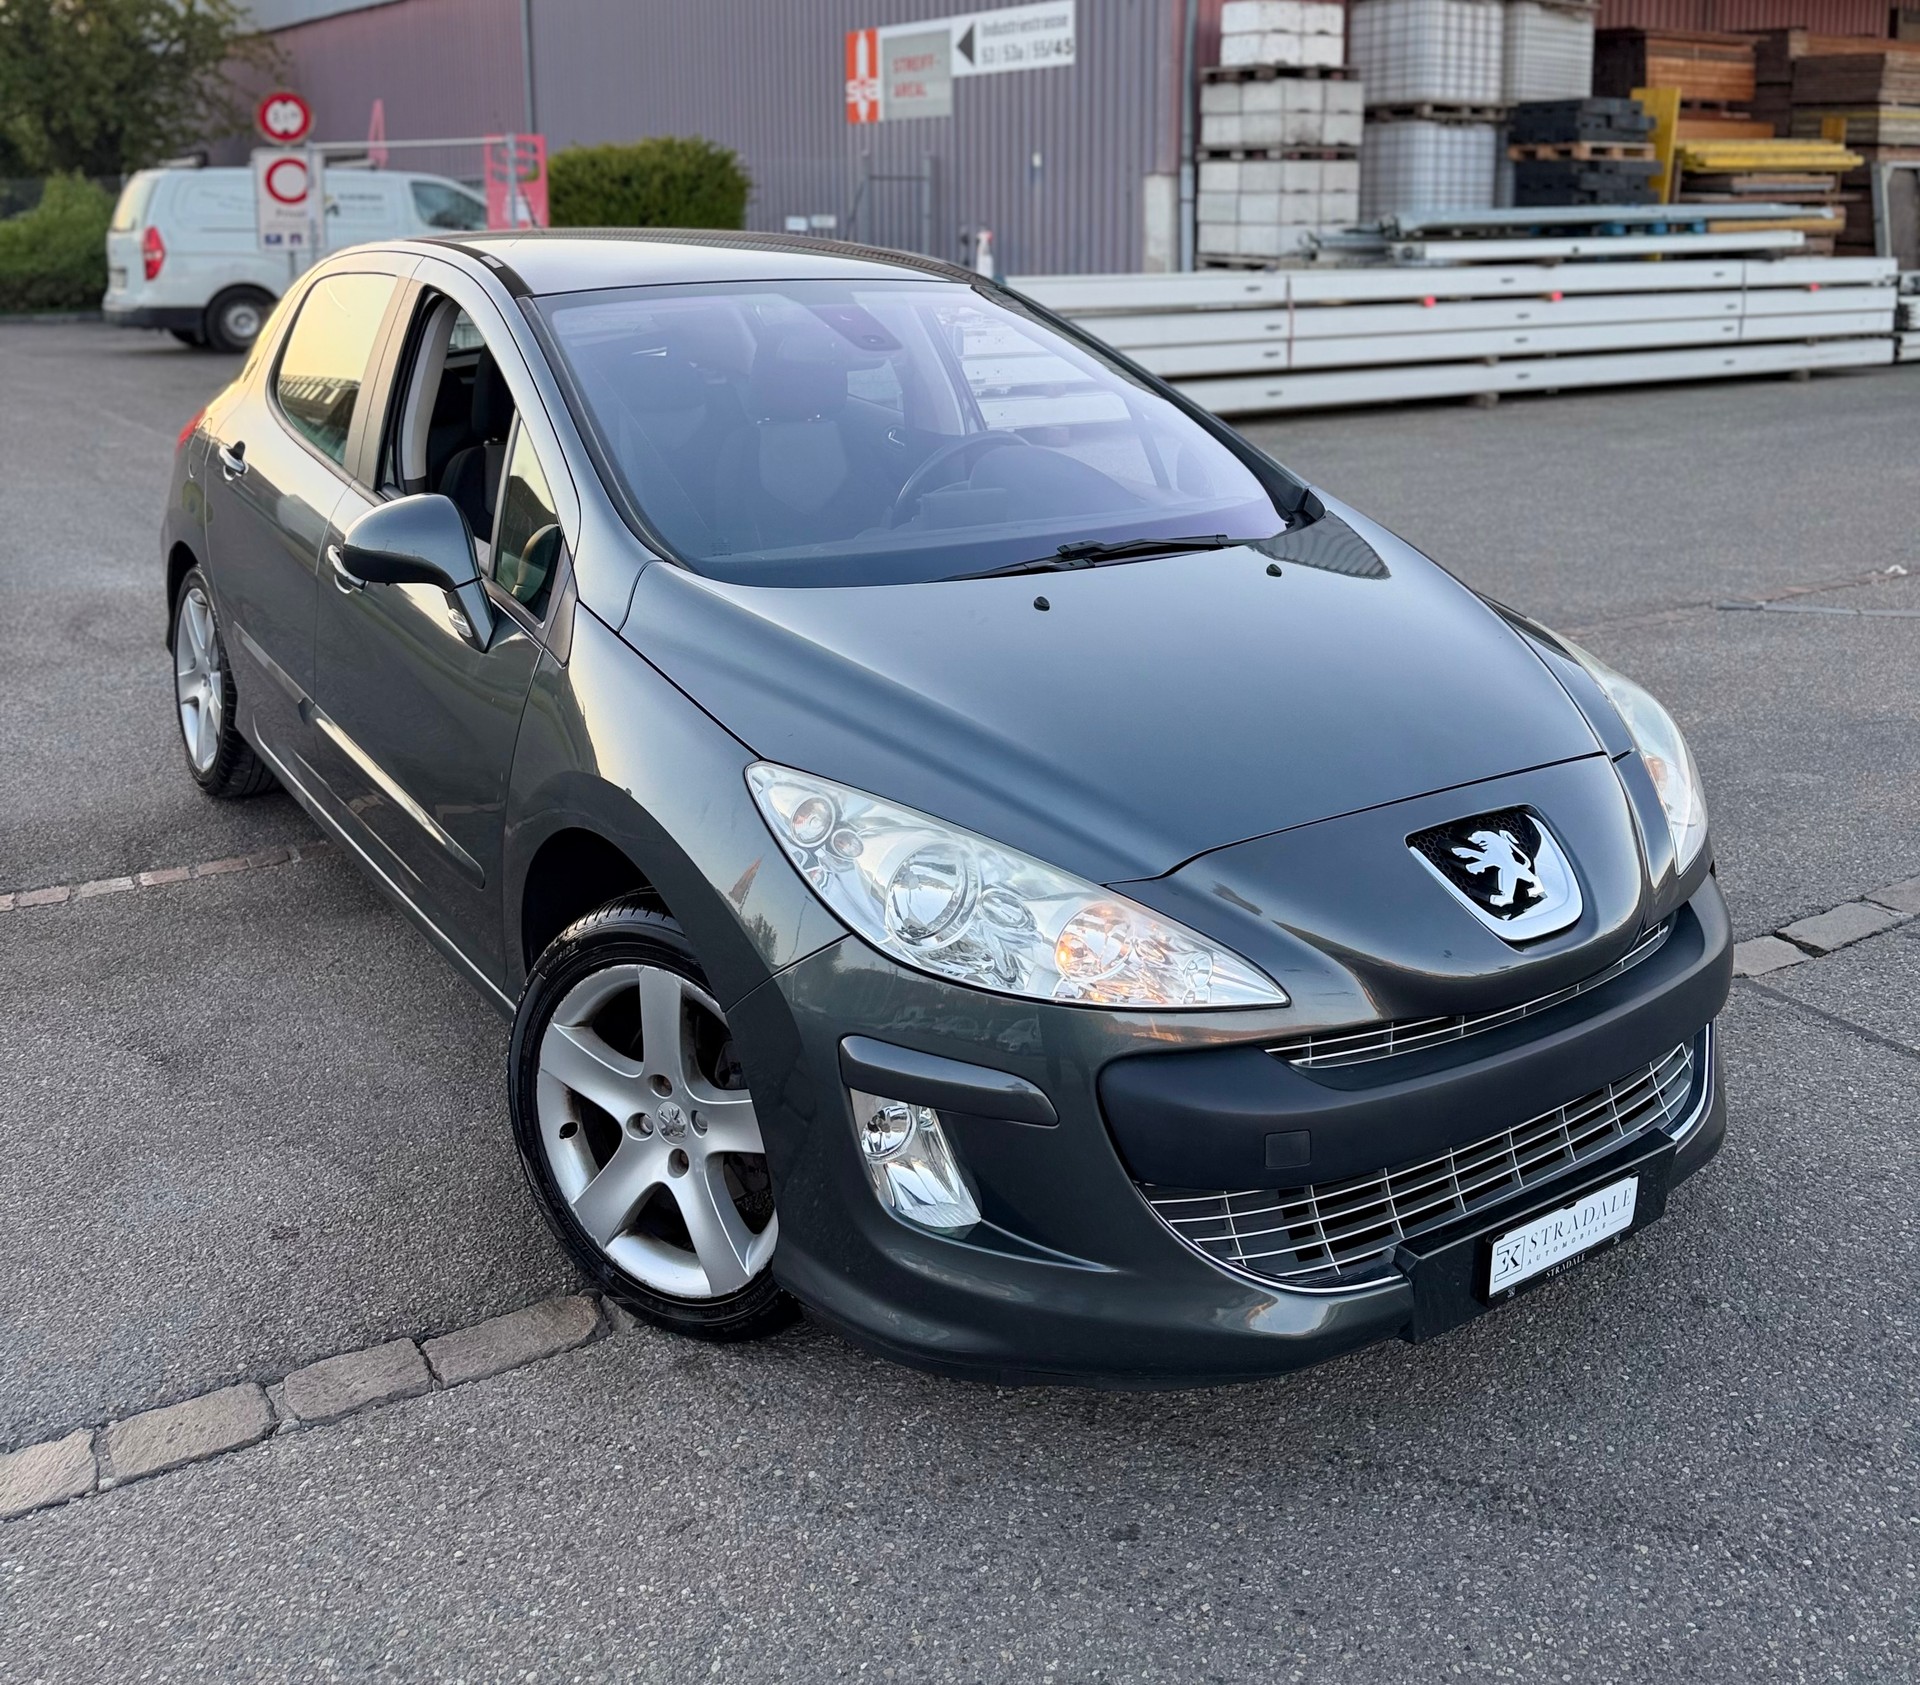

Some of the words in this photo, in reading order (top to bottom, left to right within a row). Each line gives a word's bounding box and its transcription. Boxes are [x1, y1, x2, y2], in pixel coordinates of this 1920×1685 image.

[982, 14, 1068, 38] Industriestrasse
[1528, 1187, 1632, 1253] STRADALE
[1527, 1223, 1607, 1266] AUTOMOBILE
[1545, 1252, 1587, 1280] STRADALE
